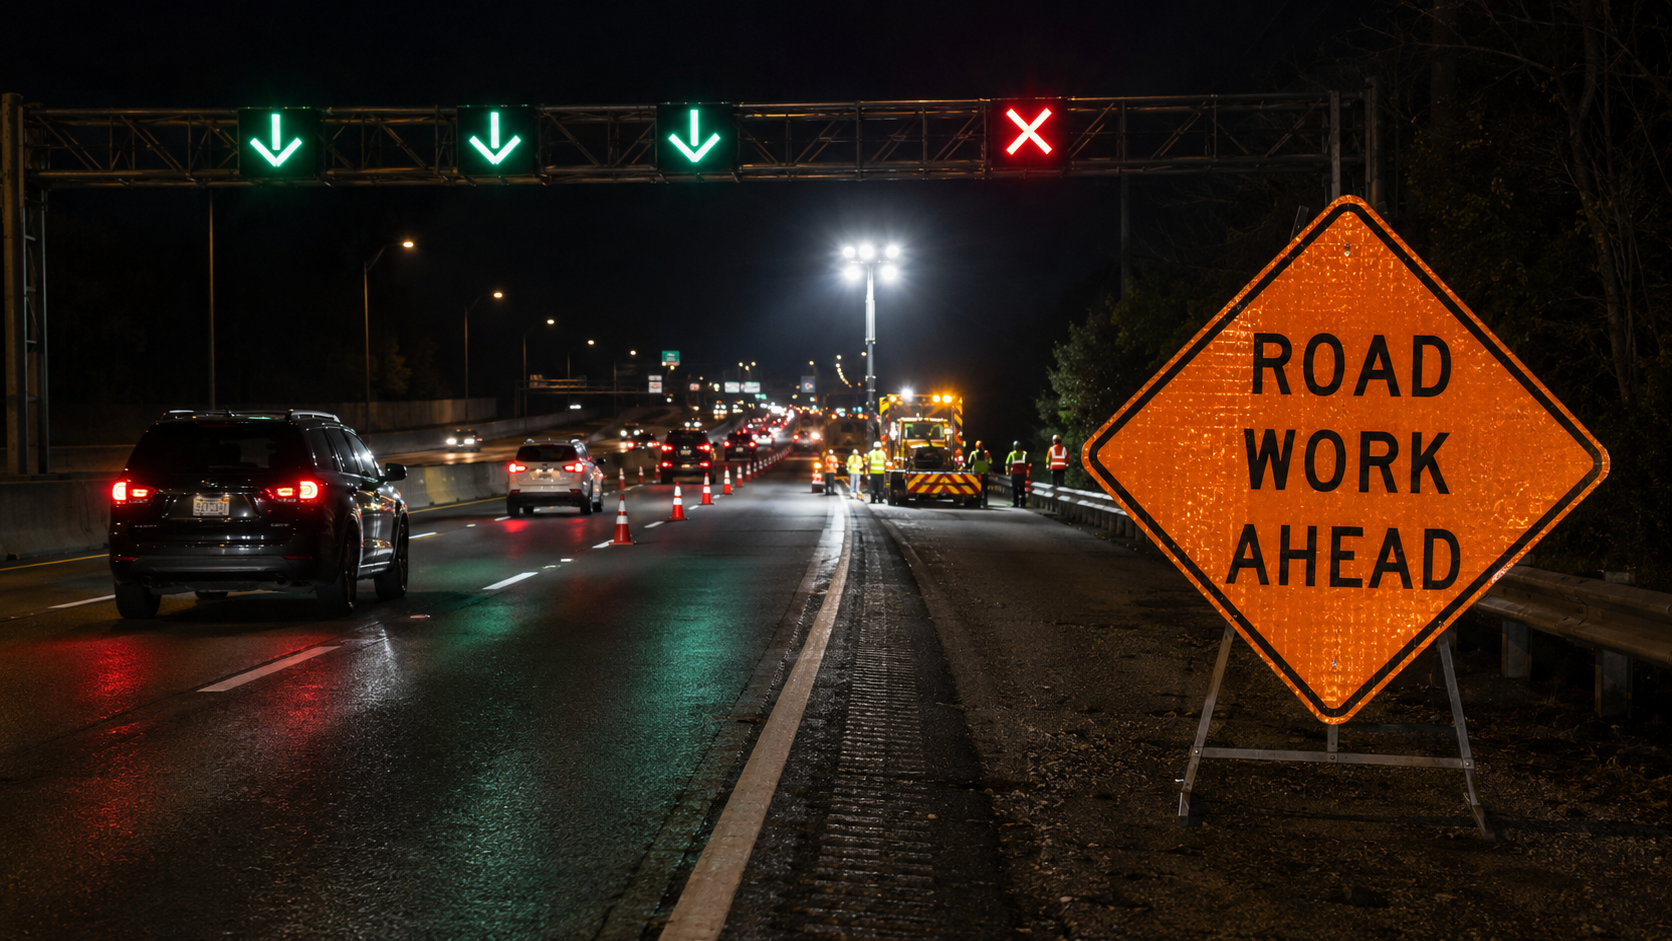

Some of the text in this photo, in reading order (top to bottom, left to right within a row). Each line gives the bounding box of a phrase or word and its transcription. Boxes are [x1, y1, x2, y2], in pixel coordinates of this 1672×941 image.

[1252, 333, 1451, 397] ROAD
[1244, 429, 1449, 494] WORK
[1226, 524, 1460, 590] AHEAD
